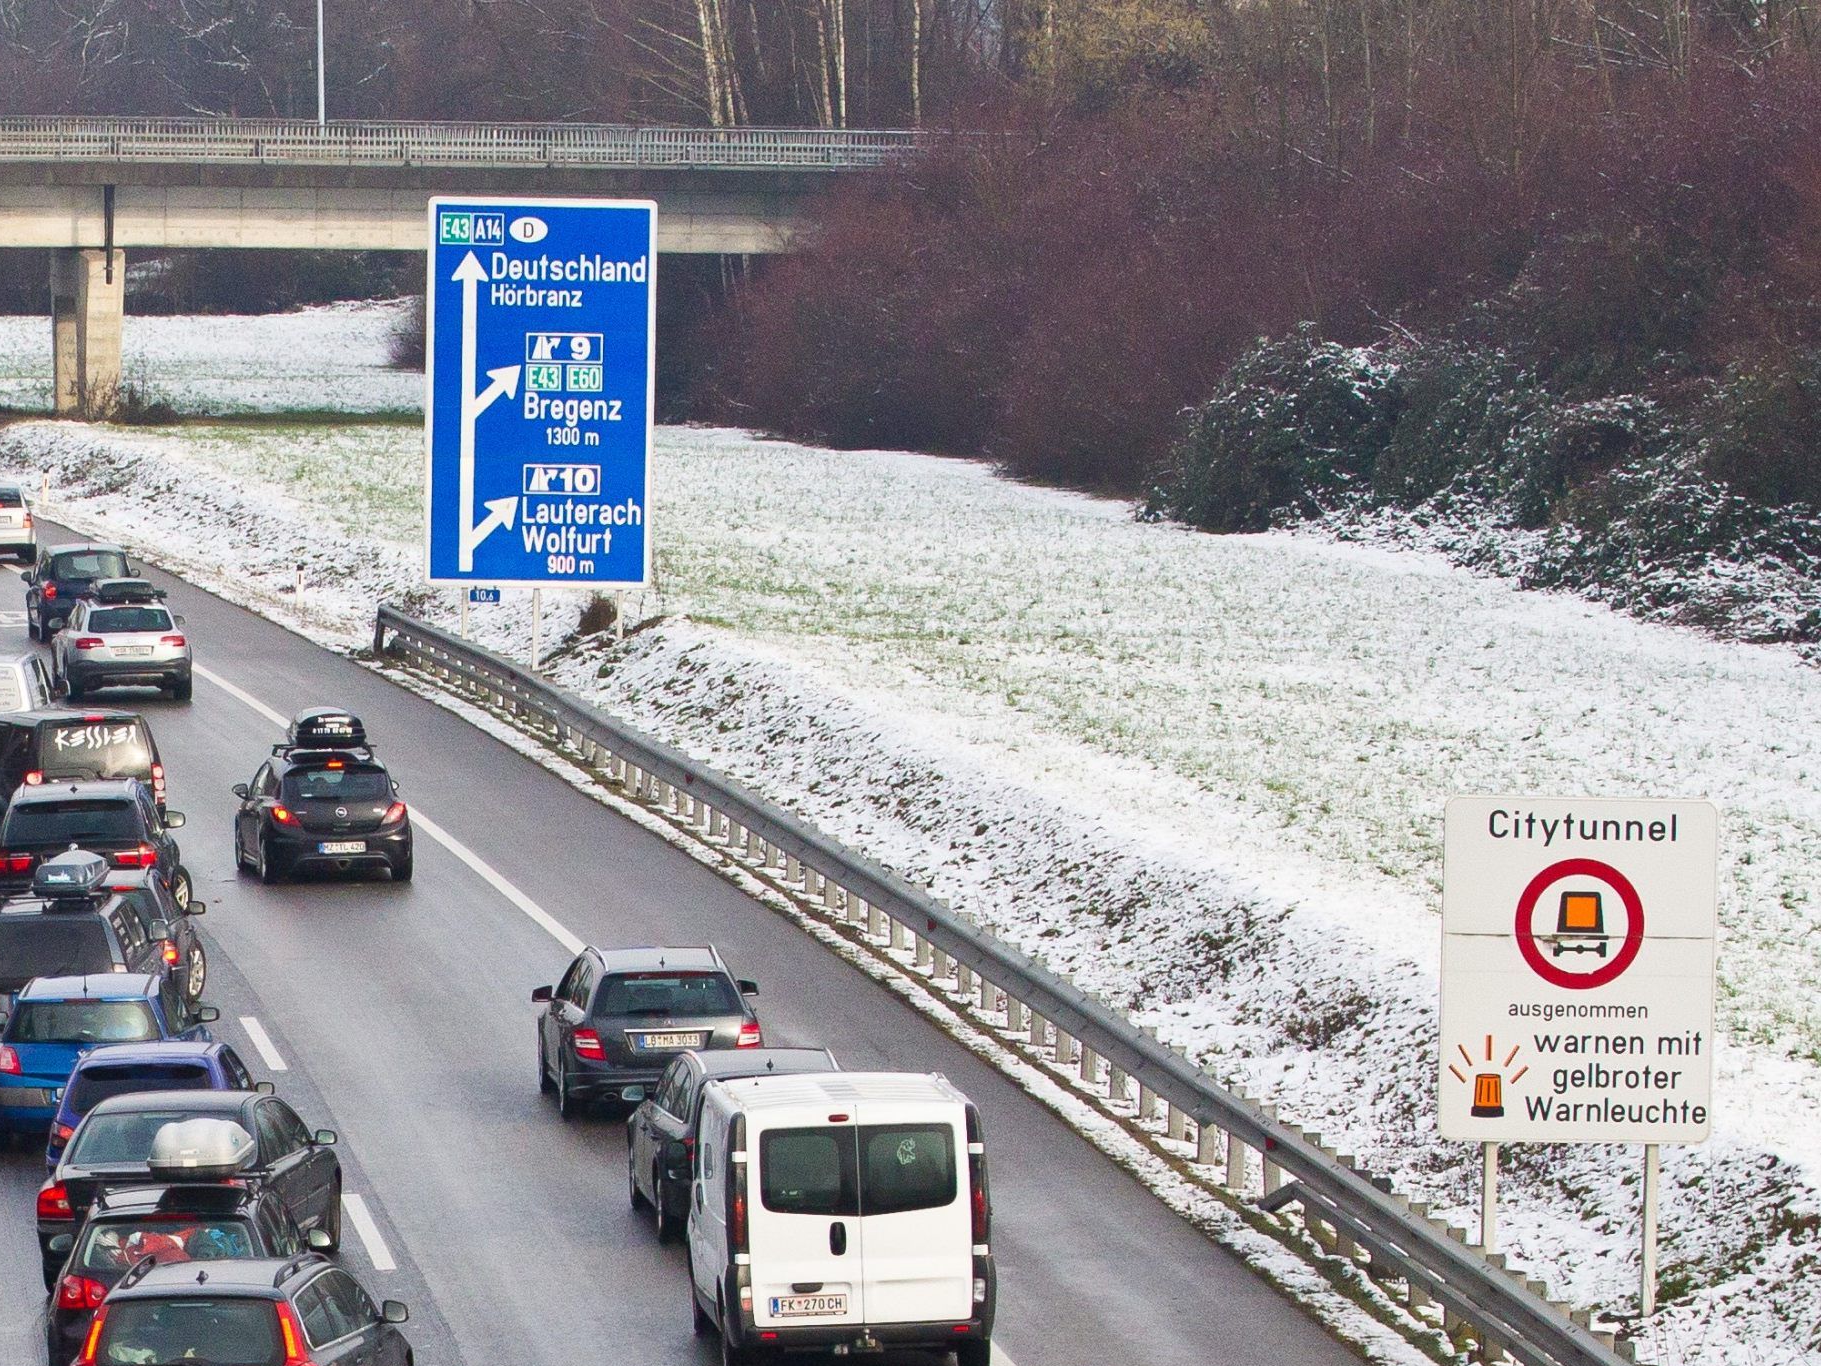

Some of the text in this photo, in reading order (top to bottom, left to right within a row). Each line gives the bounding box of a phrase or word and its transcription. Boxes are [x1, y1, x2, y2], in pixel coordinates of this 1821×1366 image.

[442, 218, 534, 239] E43 A14 D
[491, 252, 646, 282] Deutschland
[491, 283, 583, 307] Hörbranz
[570, 336, 591, 361] 9
[528, 367, 599, 389] E43 E60
[524, 391, 622, 427] Bregenz
[546, 427, 599, 445] 1300 m
[559, 467, 595, 492] 10
[522, 496, 641, 525] Lauterach
[522, 526, 612, 554] Wolfurt
[547, 555, 595, 574] 900 m
[1489, 809, 1677, 847] Citytunnel
[1508, 1003, 1648, 1021] ausgenommen
[1534, 1031, 1702, 1055] warnen mit
[1553, 1062, 1682, 1094] gelbroter
[1525, 1096, 1707, 1124] Warnleuchte
[781, 1298, 842, 1311] FK 270 CH
